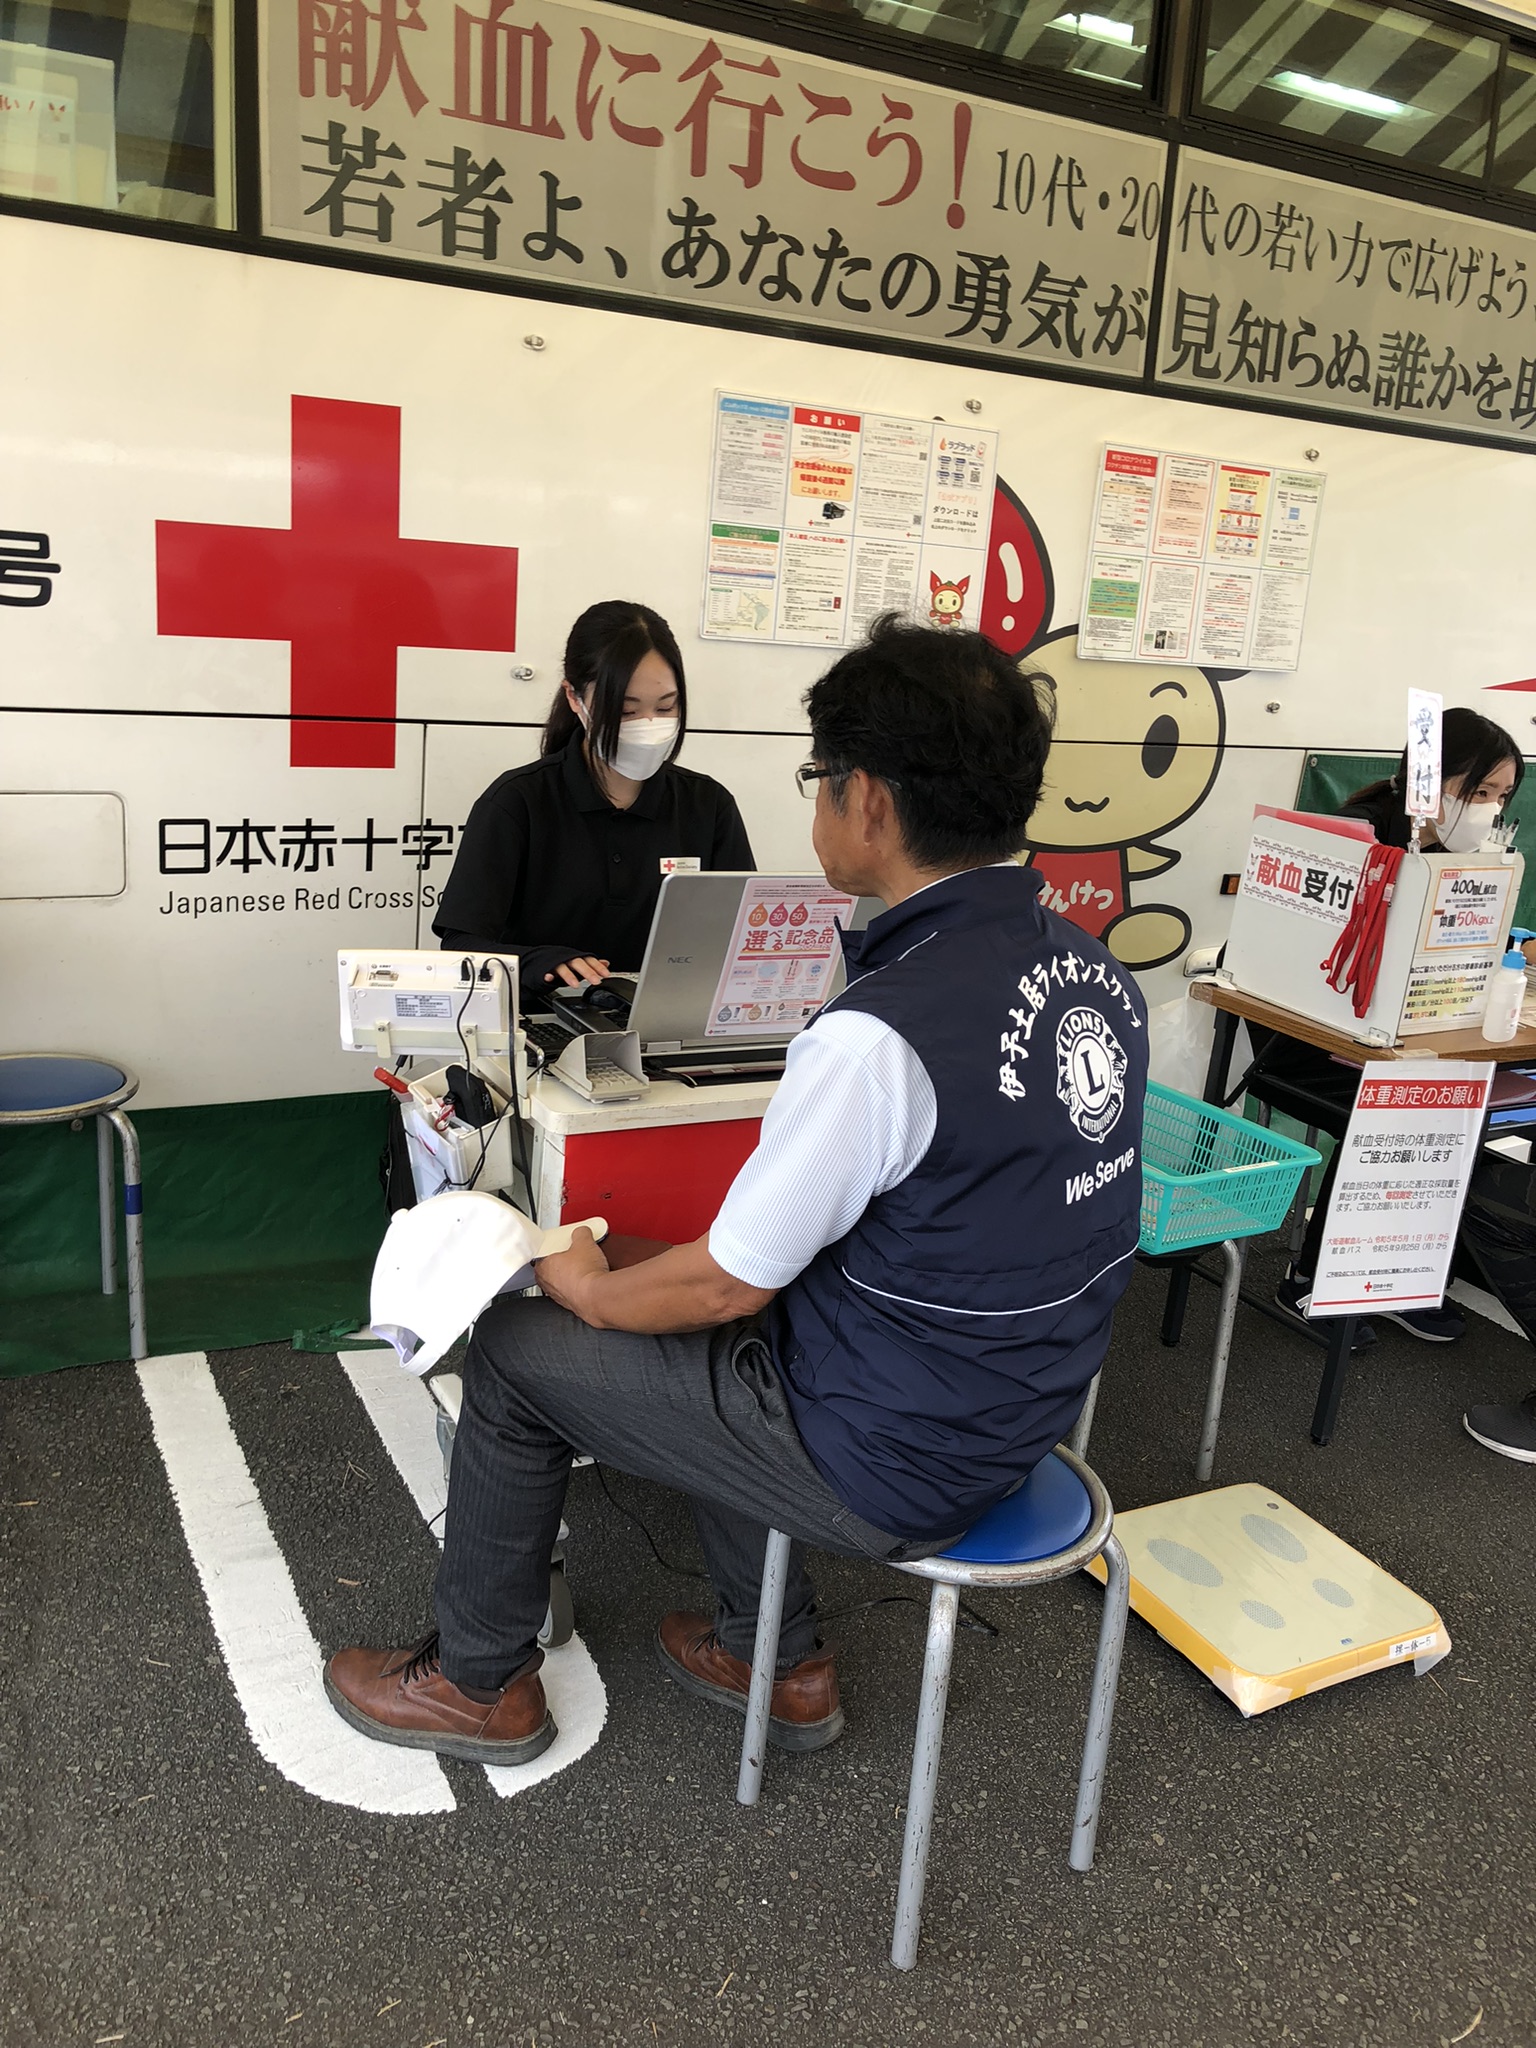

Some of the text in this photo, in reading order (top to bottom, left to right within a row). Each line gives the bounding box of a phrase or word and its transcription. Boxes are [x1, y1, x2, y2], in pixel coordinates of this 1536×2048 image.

[301, 120, 1146, 359] 若者よ、あなたの勇気が
[1178, 182, 1536, 322] 代の若い力で広げよう
[159, 818, 466, 875] 日本赤十字
[1256, 853, 1354, 911] 献血受付
[160, 891, 285, 918] Japanese
[294, 888, 340, 911] Red
[348, 886, 413, 909] Cross
[742, 928, 835, 951] 選べる記念品
[667, 956, 693, 964] NEC
[1060, 1012, 1103, 1046] LIONS
[1081, 1049, 1106, 1097] L
[1360, 1085, 1482, 1106] 体重測定のお願い
[1080, 1100, 1120, 1132] INTERNATIONAL
[1352, 1133, 1466, 1148] 献血受付時の体重測定に
[1359, 1149, 1453, 1164] ご協力お願いします
[1066, 1147, 1135, 1205] We Serve
